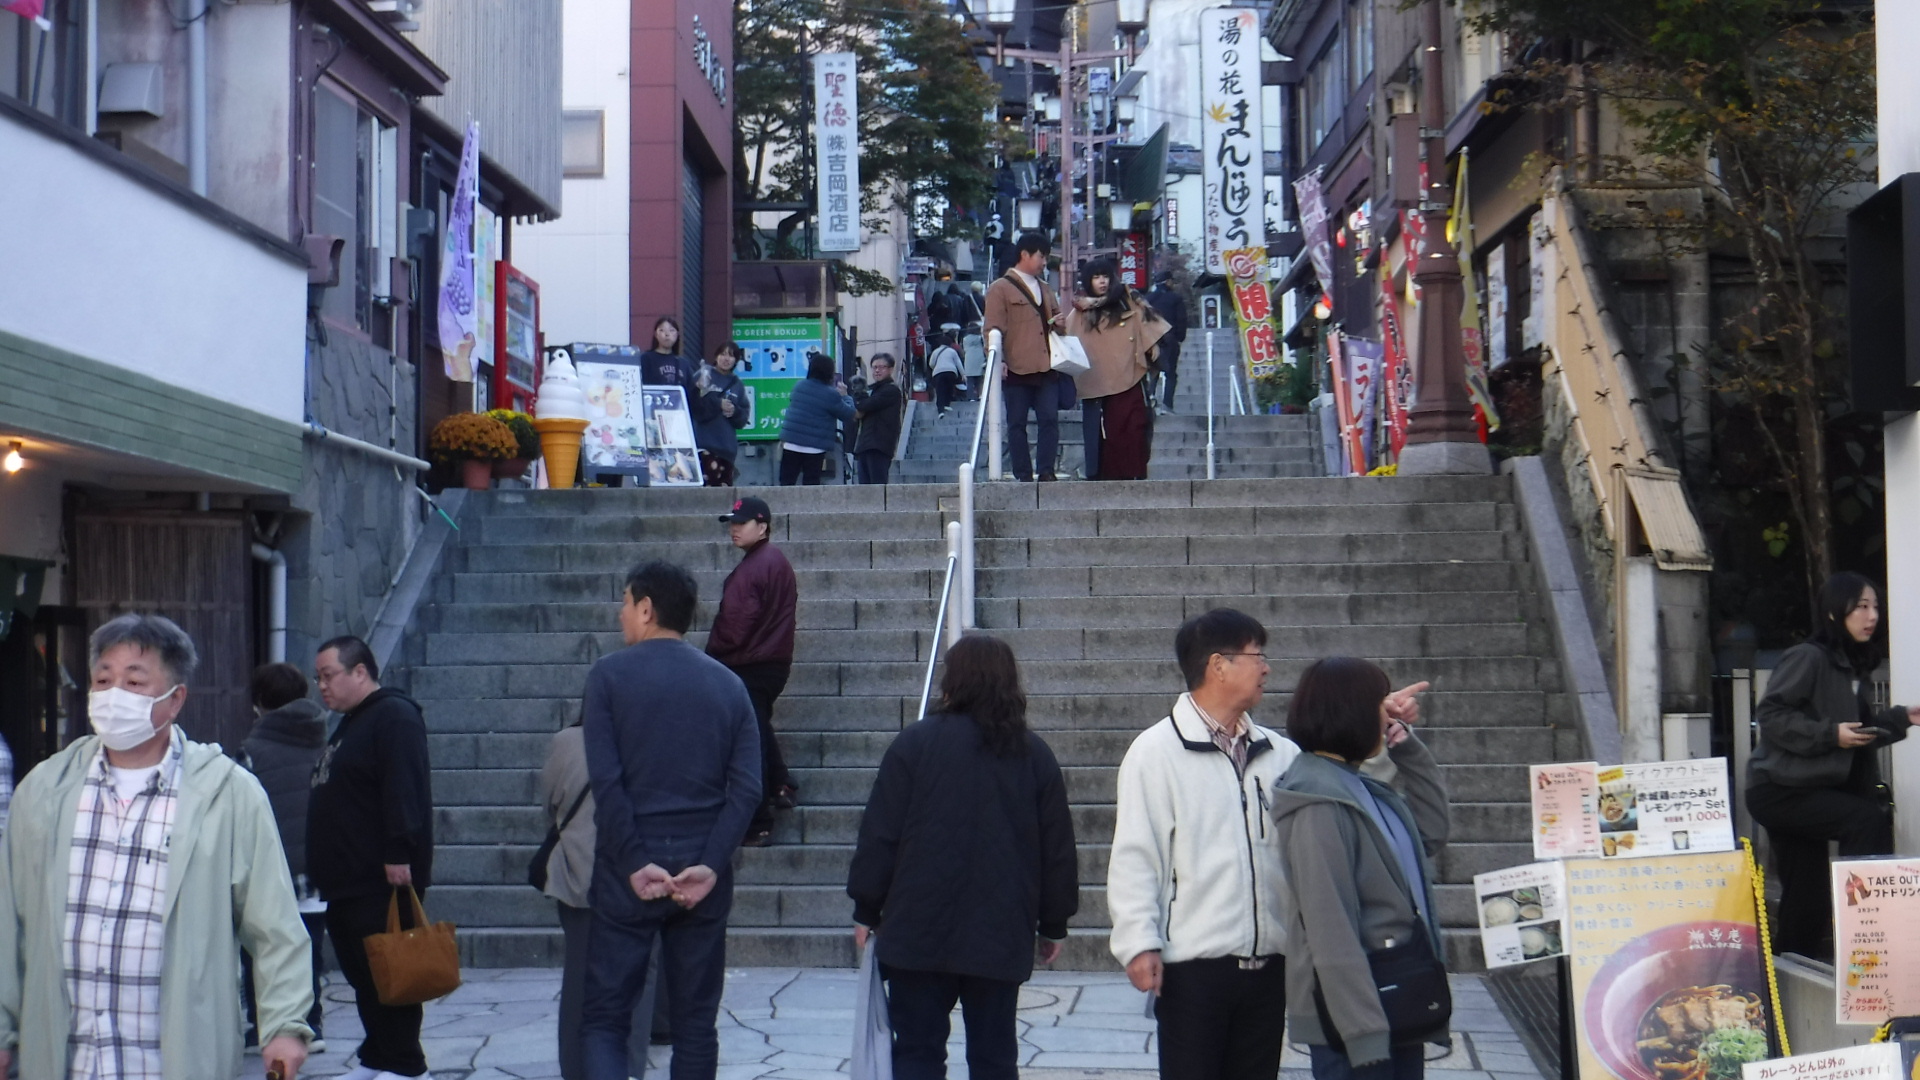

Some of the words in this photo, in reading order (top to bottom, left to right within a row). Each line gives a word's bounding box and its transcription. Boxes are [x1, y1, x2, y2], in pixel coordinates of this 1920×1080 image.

[824, 72, 852, 127] 聖徳
[744, 328, 771, 336] GREEN
[774, 327, 808, 336] BOKUJO
[760, 415, 784, 429] グリ
[1624, 765, 1700, 780] テイクアウト
[1644, 802, 1702, 813] レモンサワー
[1705, 799, 1727, 809] Set
[1867, 876, 1895, 886] TAKE
[1899, 875, 1920, 885] OUT
[1848, 1004, 1888, 1012] ドリンクセット
[1760, 1057, 1846, 1079] カレーうどん以外の
